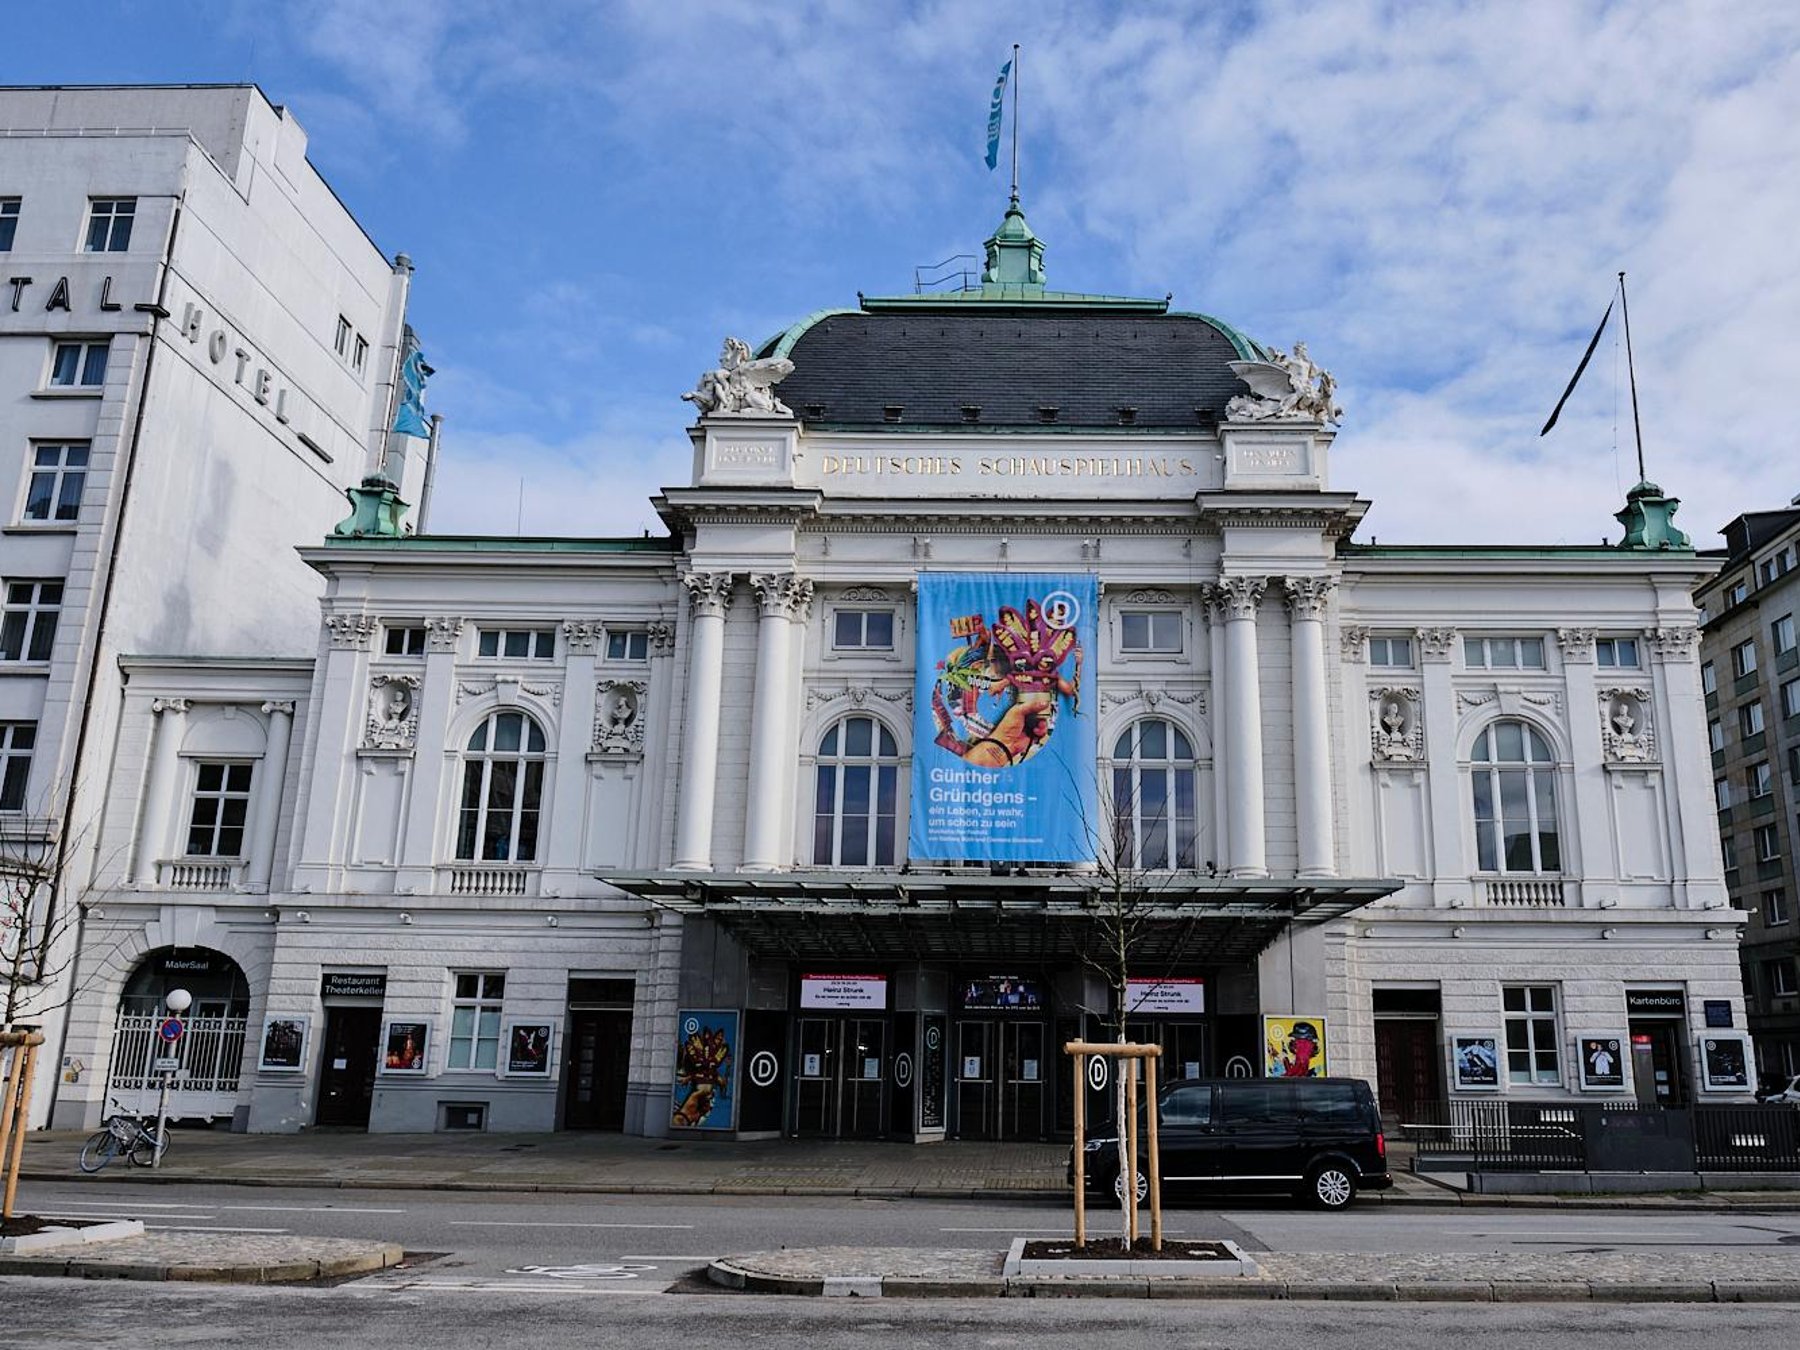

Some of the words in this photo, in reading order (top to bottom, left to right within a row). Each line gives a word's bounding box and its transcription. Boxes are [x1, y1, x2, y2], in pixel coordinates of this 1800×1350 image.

[10, 276, 122, 312] TAL
[180, 302, 290, 425] HOTEL
[822, 455, 962, 475] DEUTSCHES
[978, 456, 1199, 477] SCHAUSPIELHAUS.
[929, 767, 1000, 785] Günther
[929, 787, 1025, 807] Gründgens
[928, 806, 945, 815] ein
[947, 807, 981, 817] Leben,
[983, 809, 996, 817] zu
[997, 808, 1024, 818] wahr,
[928, 819, 945, 827] um
[947, 818, 979, 827] schön
[980, 820, 993, 828] zu
[995, 819, 1017, 828] sein
[165, 960, 209, 970] MalerSaal
[331, 975, 380, 985] Restaurant
[325, 985, 383, 995] Theaterkeller
[1629, 996, 1681, 1005] Kartenbüro
